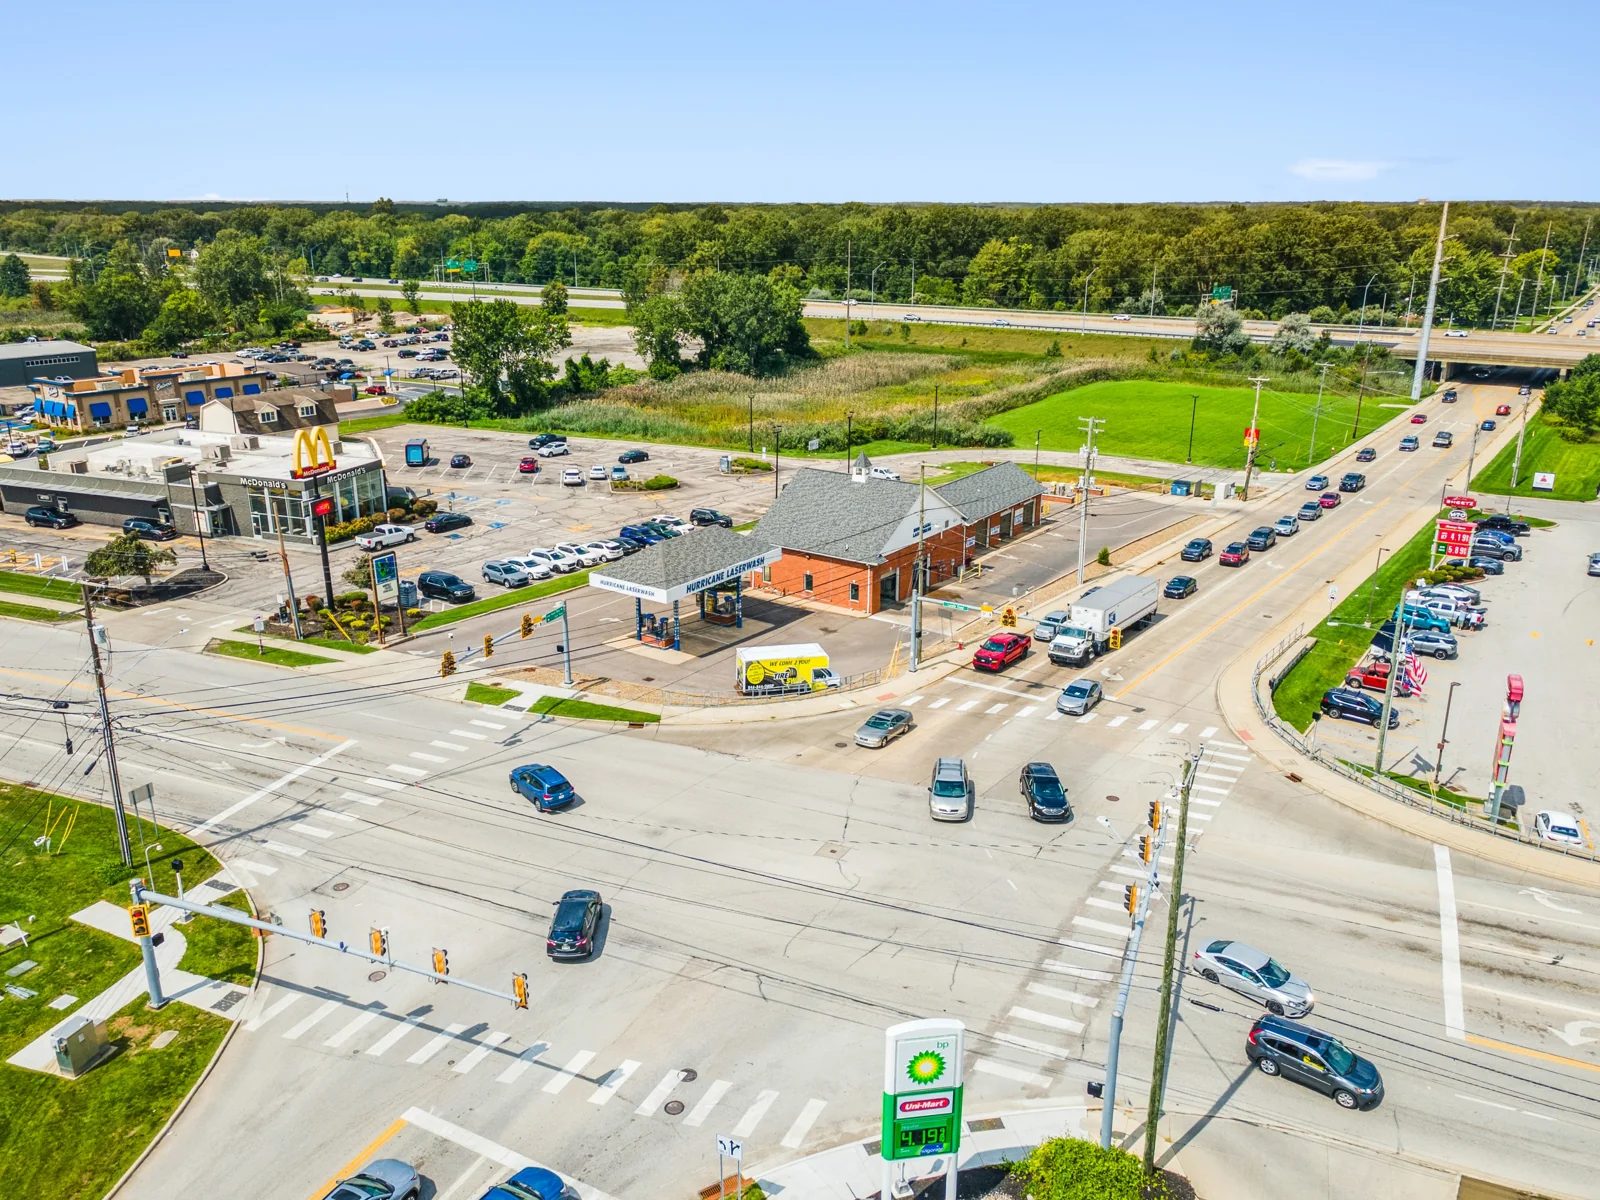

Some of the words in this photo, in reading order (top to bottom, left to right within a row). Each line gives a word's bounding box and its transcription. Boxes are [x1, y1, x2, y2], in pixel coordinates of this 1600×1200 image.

[303, 466, 330, 477] McDonald's
[327, 467, 366, 484] McDonald's
[240, 478, 286, 489] McDonald's
[687, 572, 724, 593] HURRICANE
[726, 557, 765, 579] LASERWASH
[600, 580, 626, 591] HURRICANE
[626, 585, 655, 597] LASERWASH
[774, 672, 789, 680] TIRE
[937, 1041, 949, 1049] bp
[905, 1100, 944, 1110] Uni-Mart
